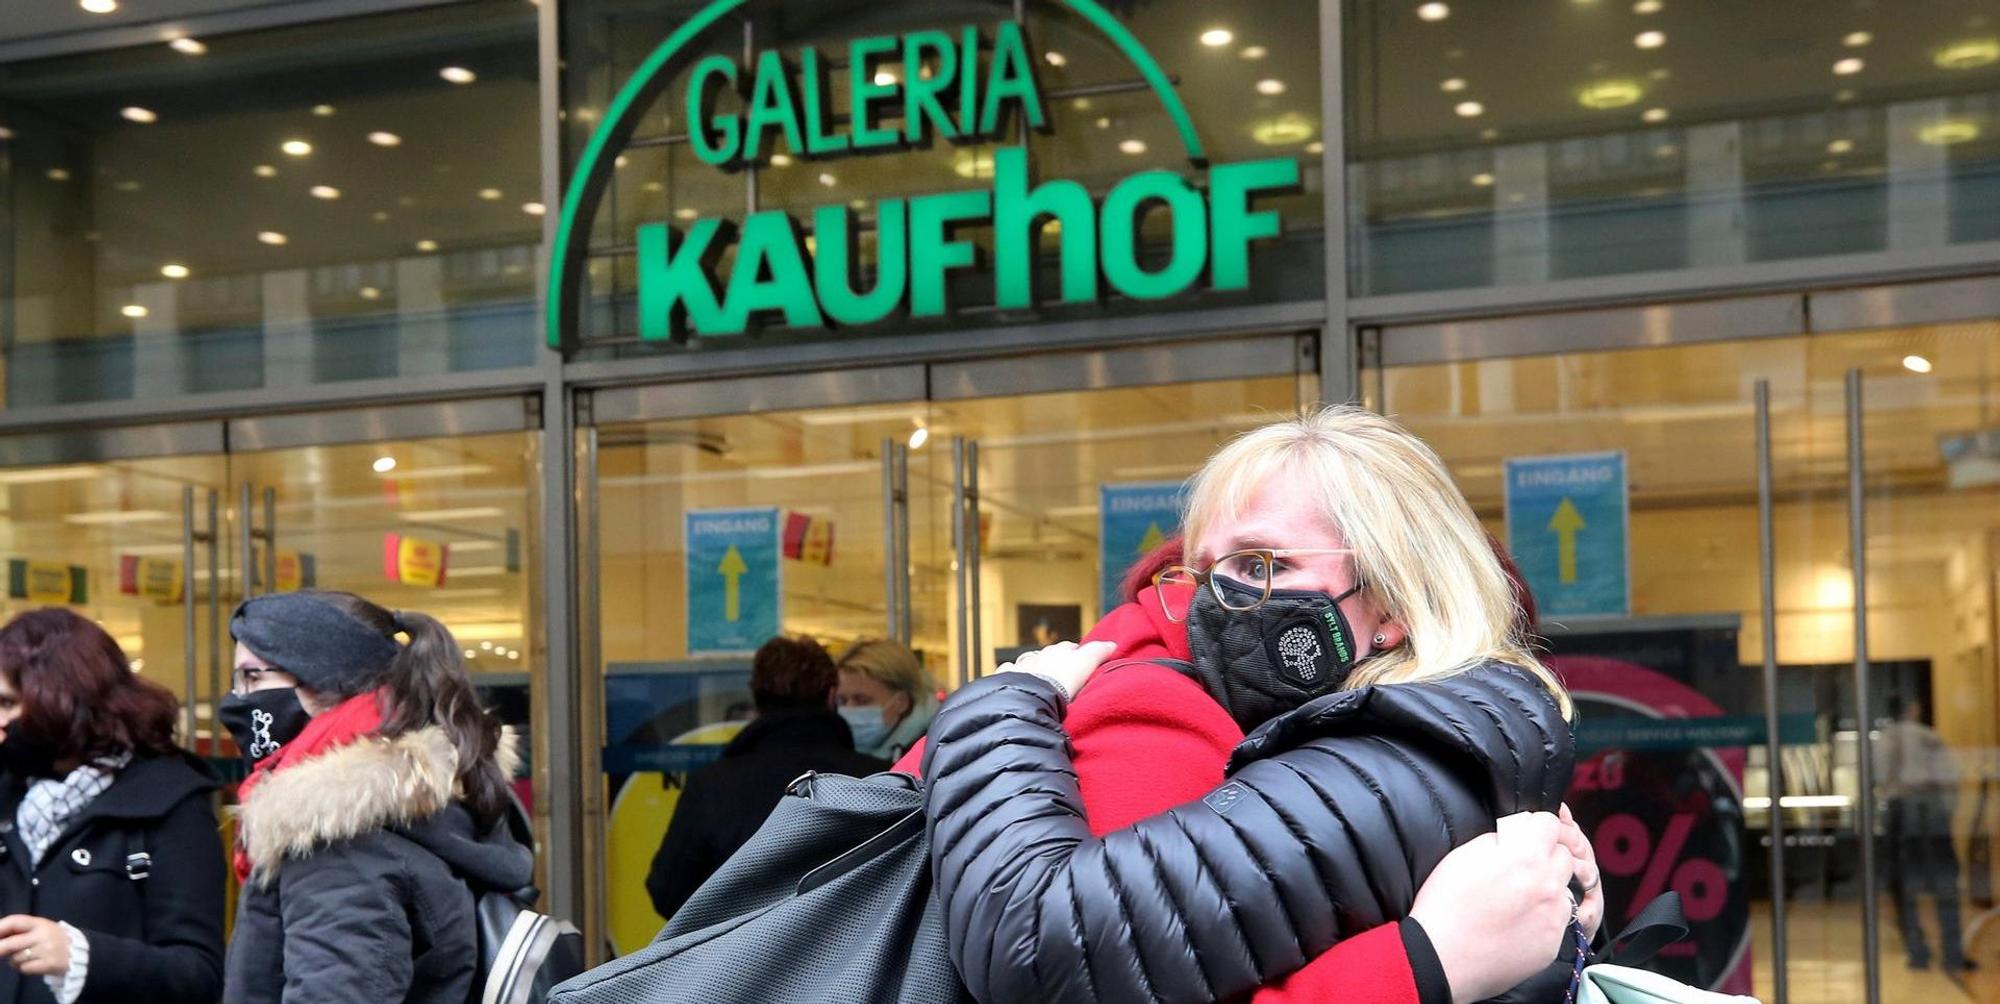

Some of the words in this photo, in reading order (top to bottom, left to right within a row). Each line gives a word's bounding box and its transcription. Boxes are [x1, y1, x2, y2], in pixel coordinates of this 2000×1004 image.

[687, 20, 1042, 164] GALERIA
[1517, 466, 1614, 488] EINGANG
[1111, 494, 1182, 513] EINGAN
[693, 517, 770, 534] EINGANG
[1325, 612, 1339, 632] SYLT
[1332, 632, 1349, 663] BRANDS
